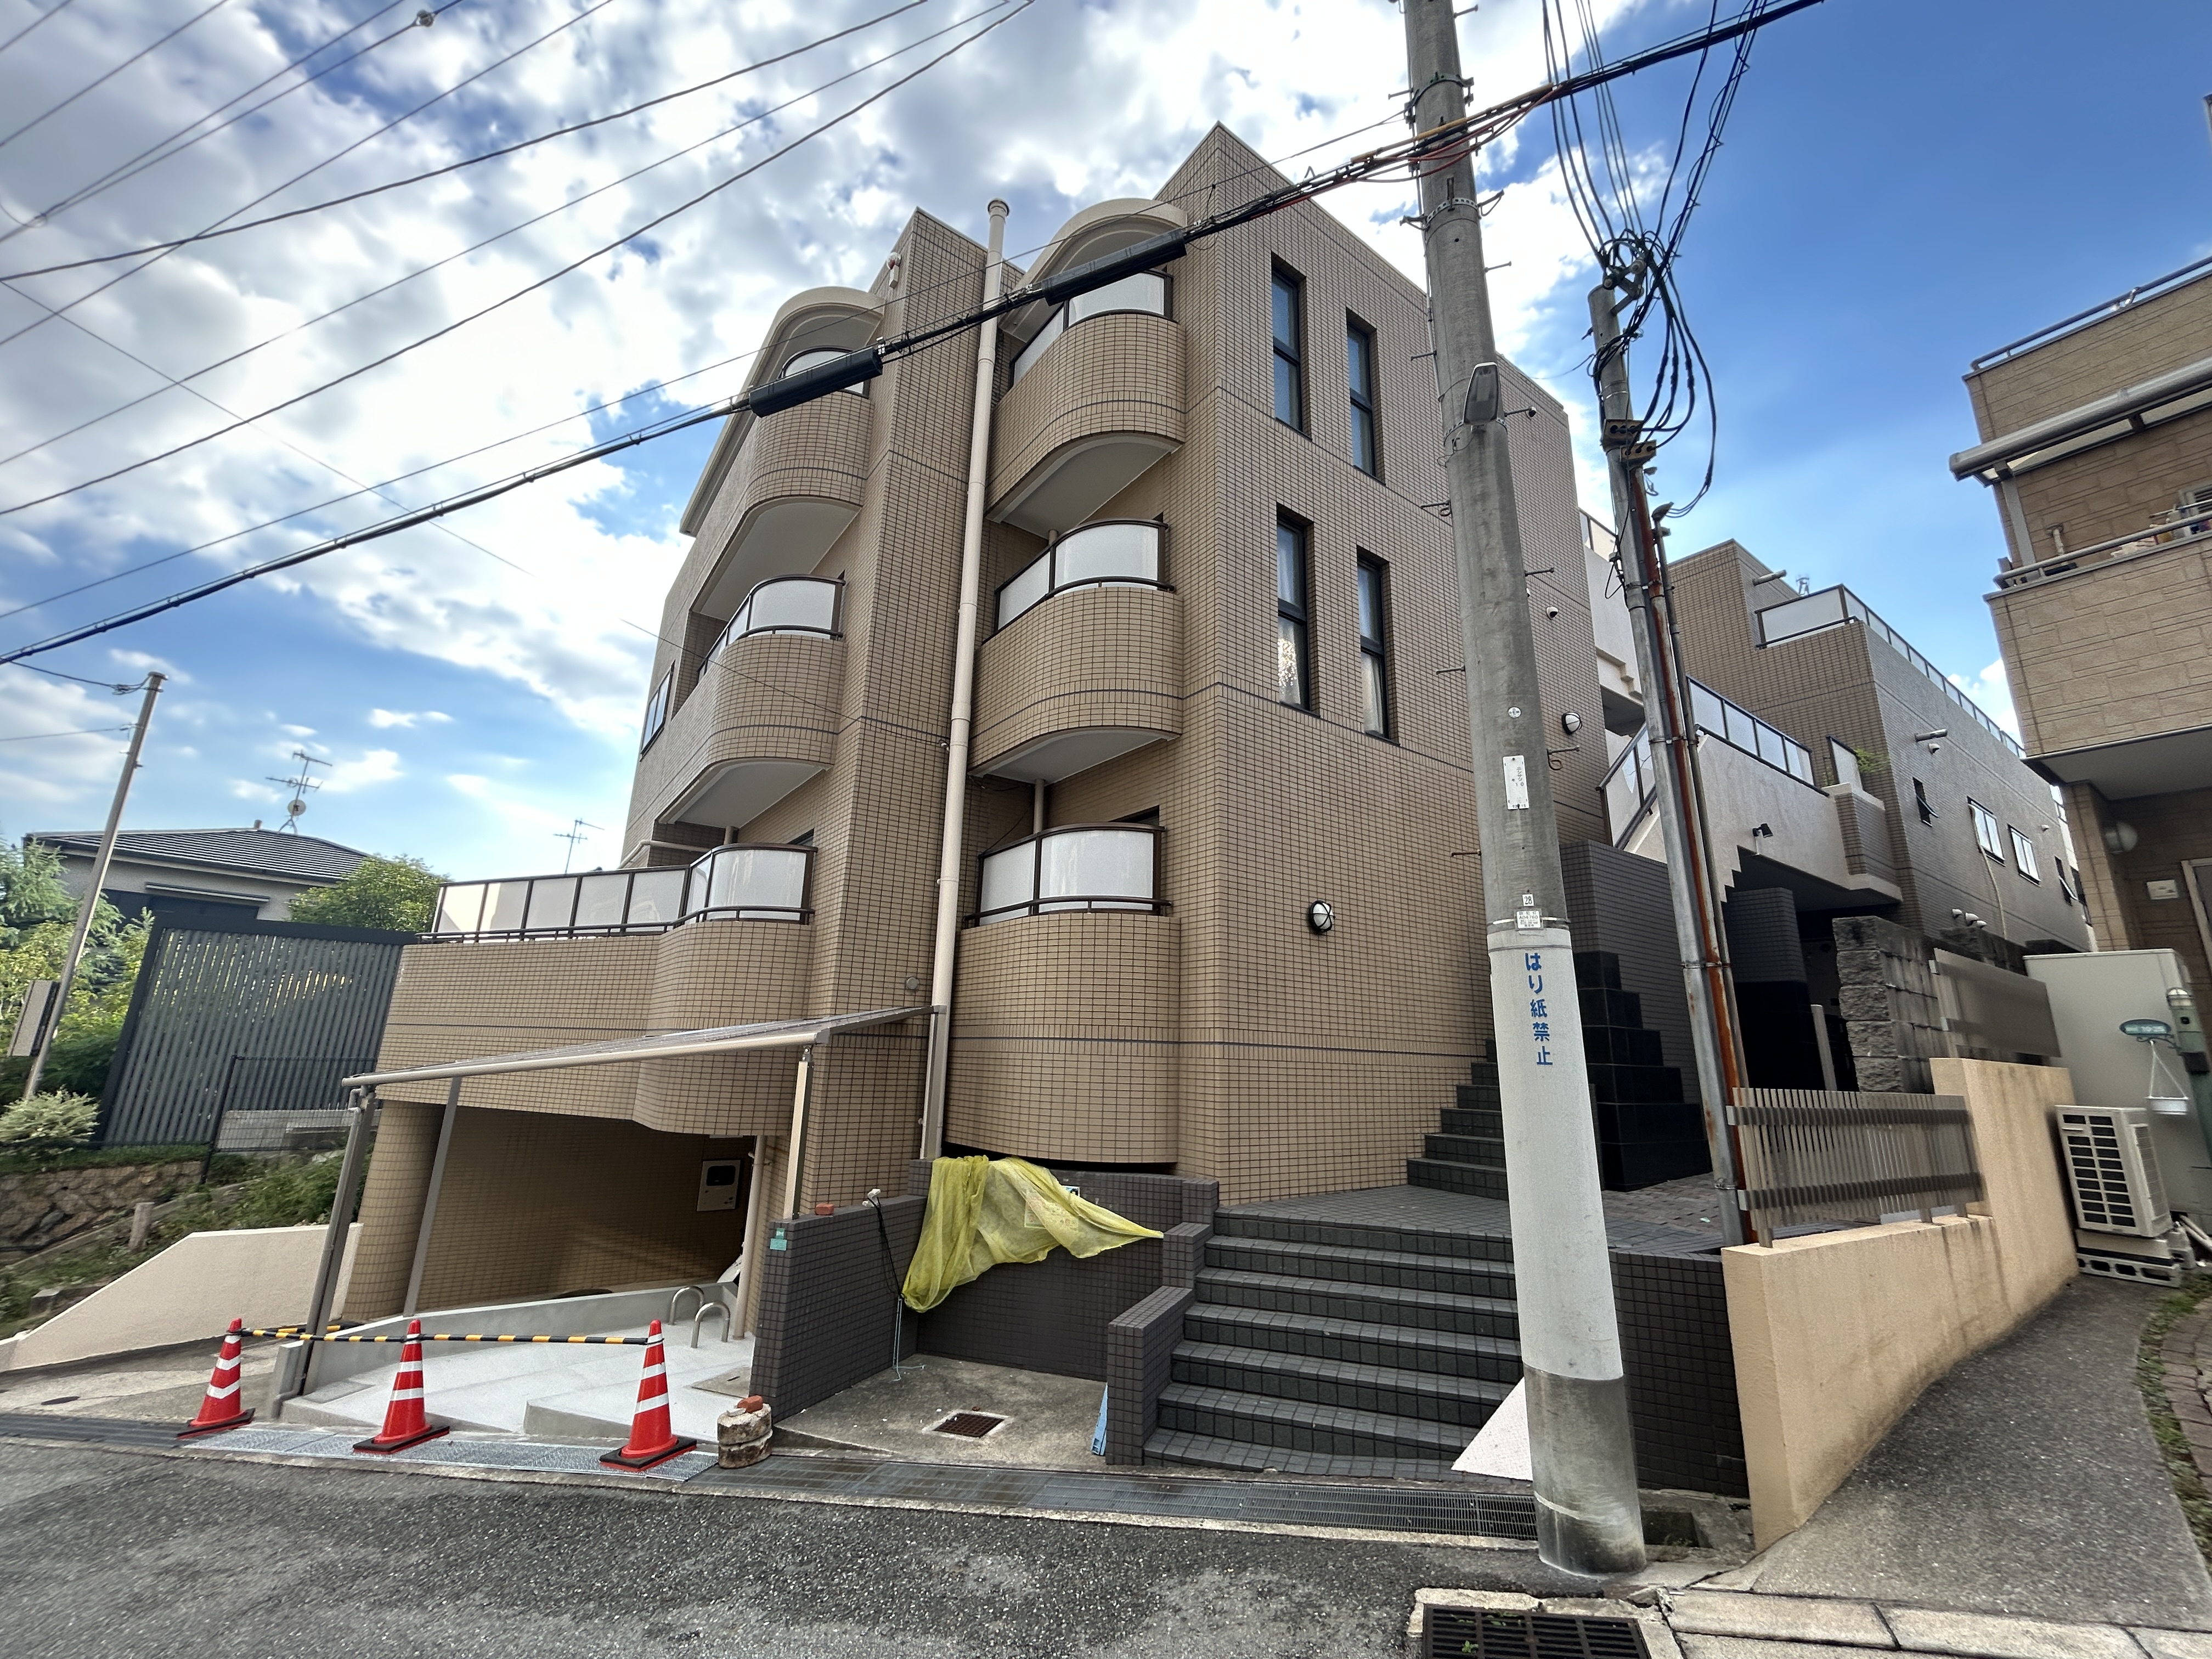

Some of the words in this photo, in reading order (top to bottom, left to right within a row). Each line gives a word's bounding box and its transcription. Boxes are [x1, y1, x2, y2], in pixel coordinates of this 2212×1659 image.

[1524, 895, 1532, 905] 28
[1525, 952, 1553, 1065] はり紙禁止
